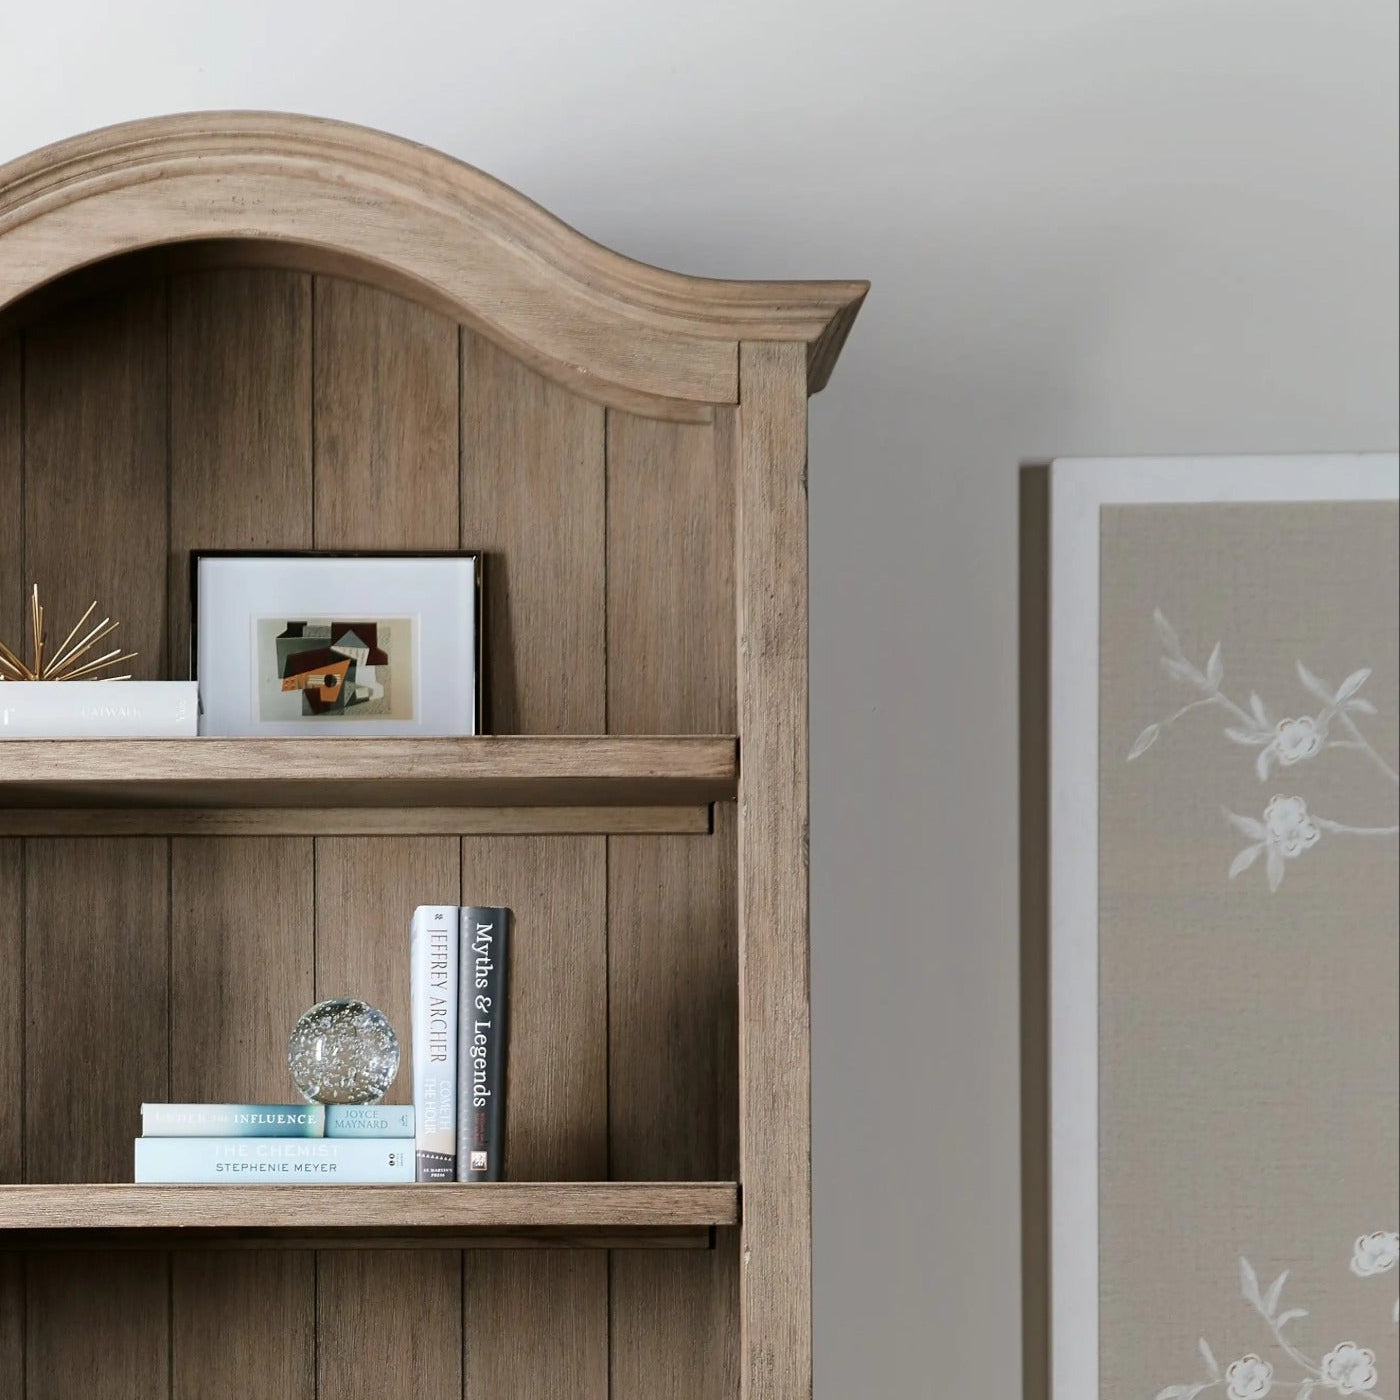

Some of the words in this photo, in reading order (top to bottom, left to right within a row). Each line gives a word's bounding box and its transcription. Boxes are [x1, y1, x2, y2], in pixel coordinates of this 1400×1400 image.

[427, 929, 448, 991] JEFFREY
[471, 922, 494, 989] Myths
[474, 994, 492, 1013] &
[429, 996, 448, 1063] ARCHER
[469, 1020, 491, 1107] Legends
[424, 1076, 436, 1098] THE
[345, 1109, 379, 1119] JOYCE
[439, 1080, 452, 1130] COMETH
[233, 1113, 317, 1125] INFLUENCE
[335, 1119, 388, 1129] MAYNARD
[424, 1101, 437, 1135] HOUR
[215, 1144, 249, 1157] THE
[255, 1144, 340, 1157] CHEMIST
[215, 1162, 290, 1172] STEPHENIE
[294, 1162, 338, 1172] MEYER
